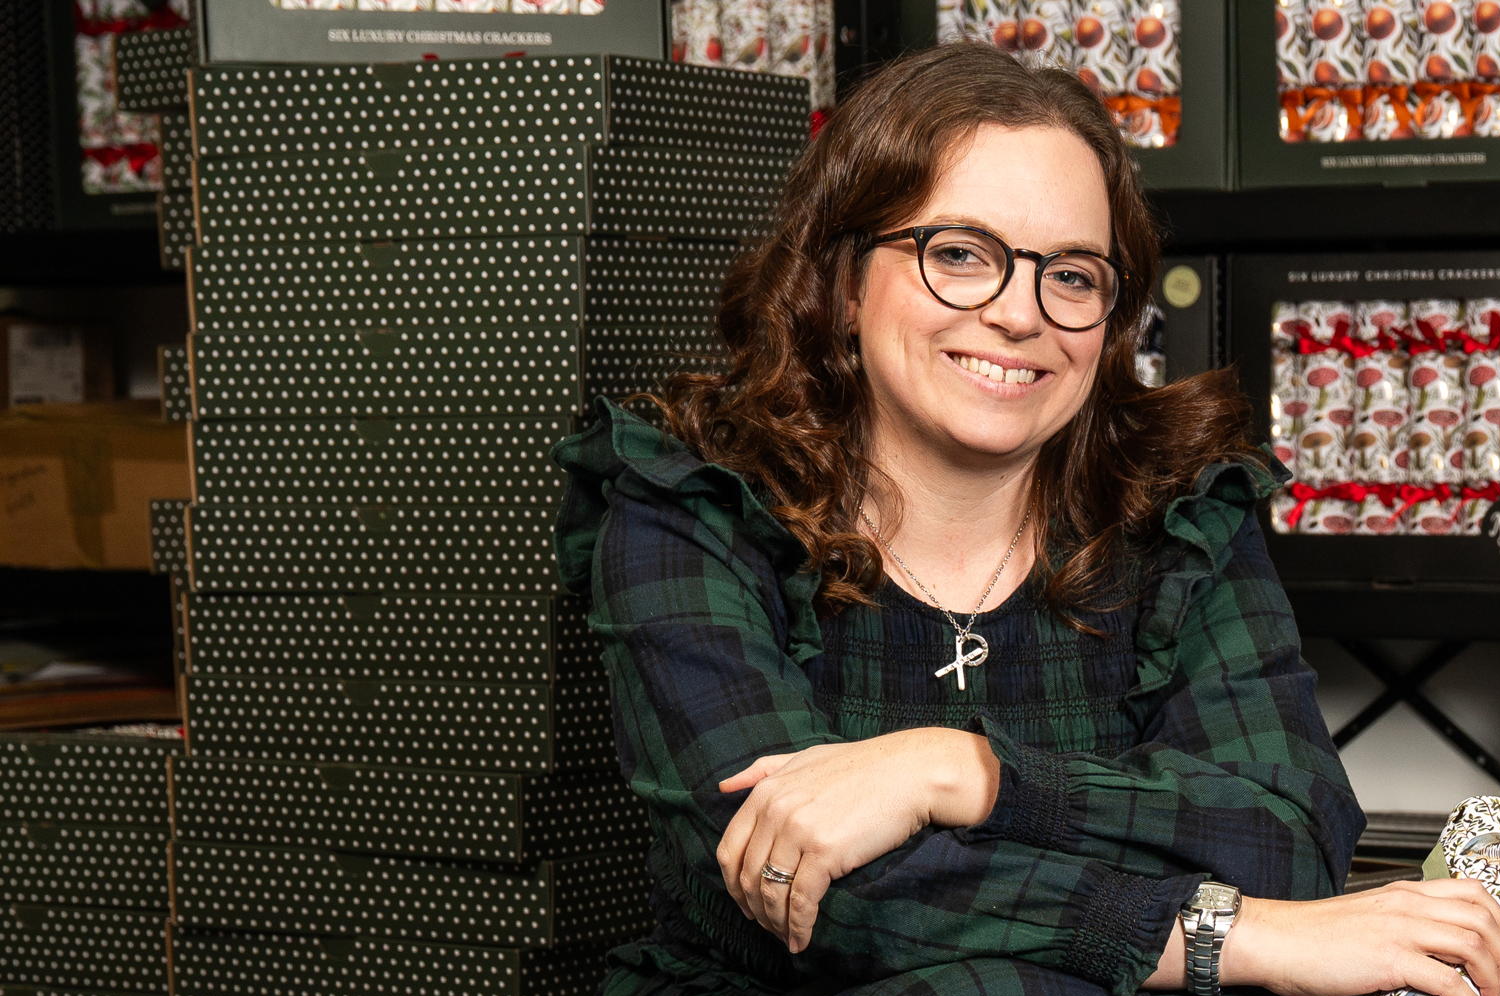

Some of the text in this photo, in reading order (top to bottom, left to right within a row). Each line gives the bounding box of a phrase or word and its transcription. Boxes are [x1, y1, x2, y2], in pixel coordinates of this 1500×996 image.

[328, 29, 552, 45] SIX LUXURY CHRISTMAS CRACKERS
[1365, 269, 1434, 281] CHRISTMAS
